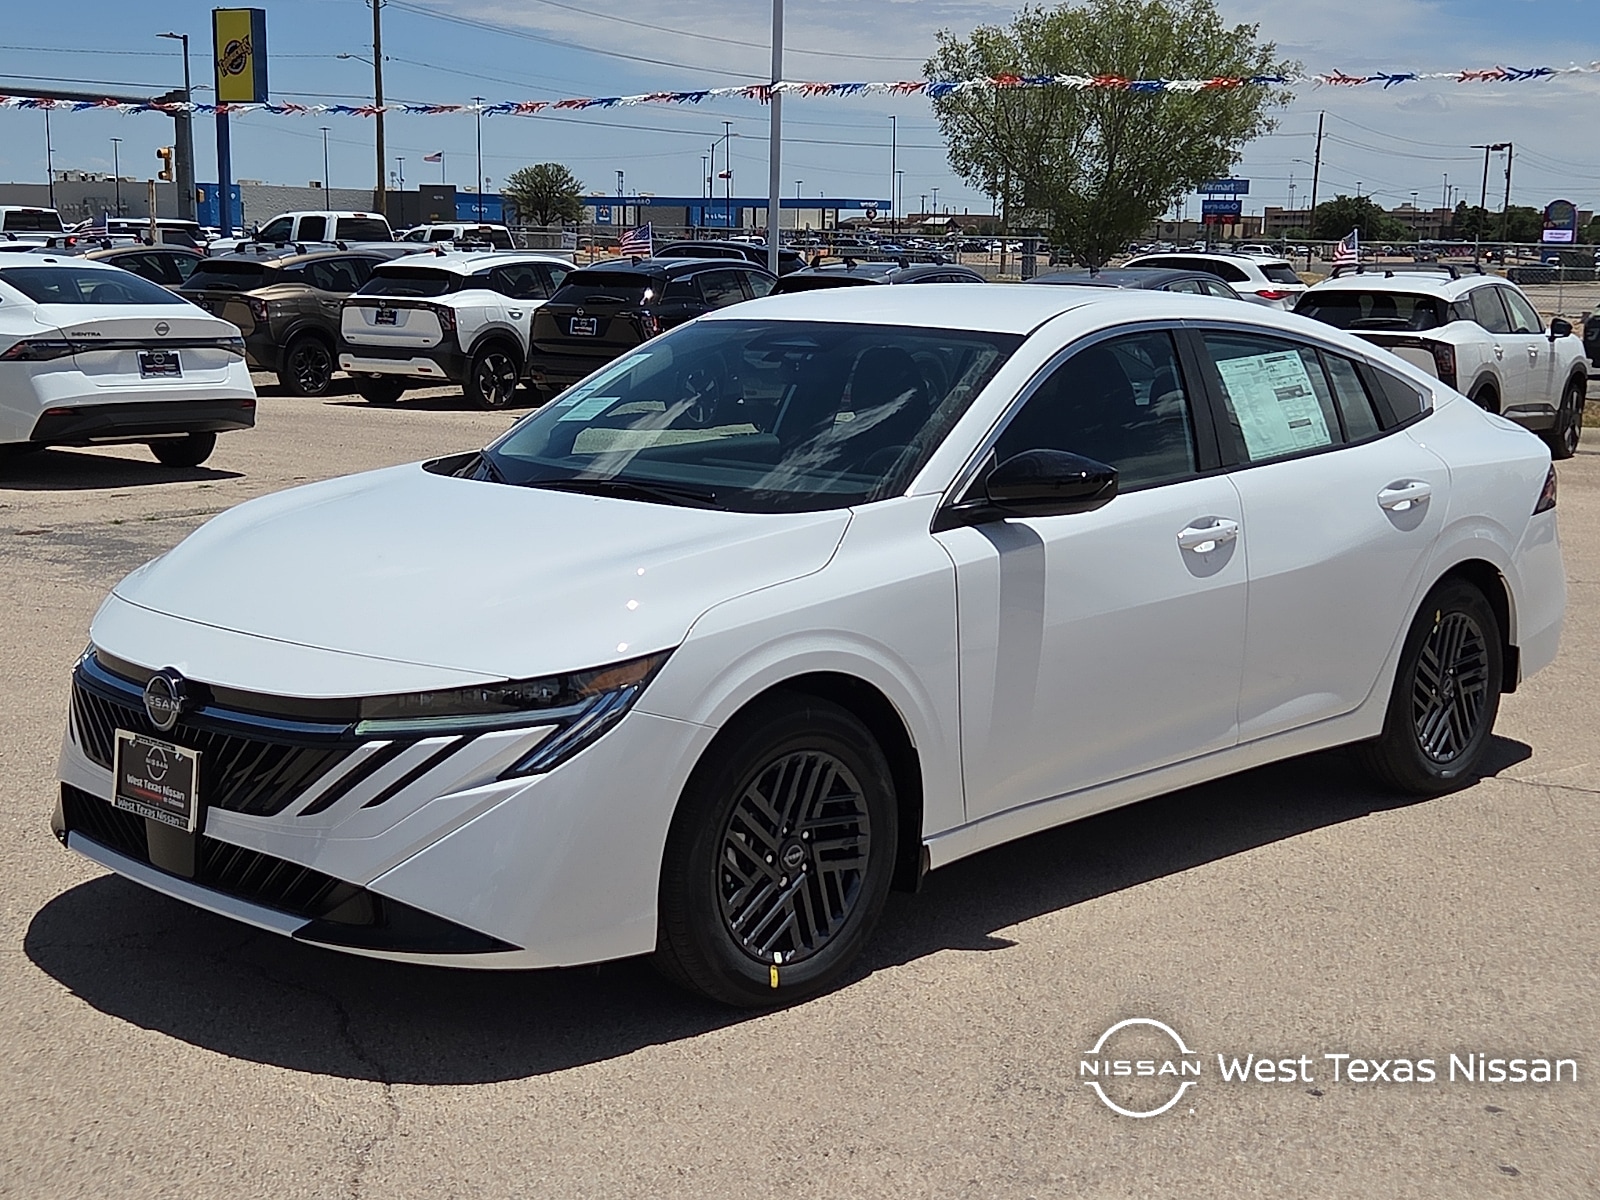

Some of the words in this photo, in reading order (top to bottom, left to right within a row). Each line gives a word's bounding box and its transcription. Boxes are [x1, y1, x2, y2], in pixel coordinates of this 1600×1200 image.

[1200, 182, 1235, 191] Wamart
[143, 693, 179, 710] SSAN
[126, 773, 143, 788] West
[143, 779, 162, 794] Texas
[162, 785, 185, 802] Nissan
[117, 797, 135, 811] West
[136, 803, 156, 819] Texas
[156, 810, 180, 827] Nissan
